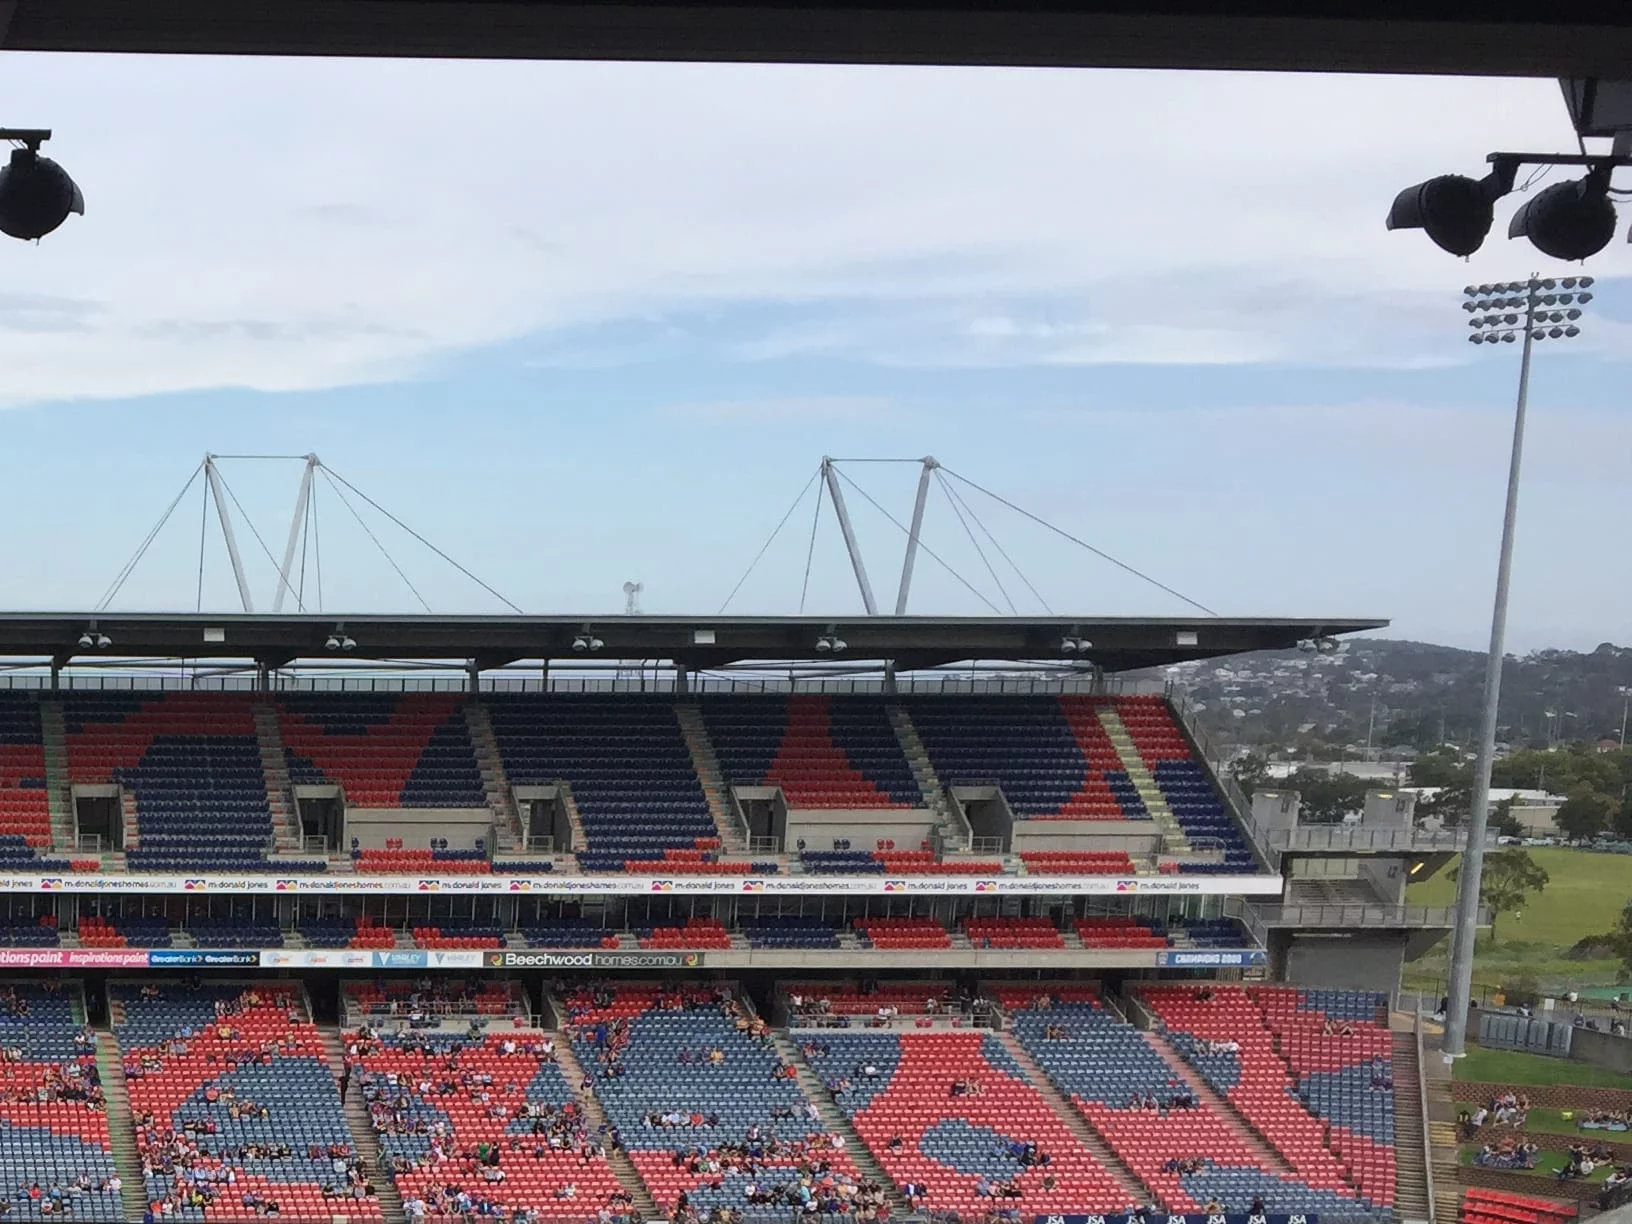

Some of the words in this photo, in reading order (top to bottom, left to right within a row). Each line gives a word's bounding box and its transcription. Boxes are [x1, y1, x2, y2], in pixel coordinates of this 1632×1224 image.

[11, 880, 33, 889] jones
[247, 880, 268, 890] jones
[505, 953, 593, 966] Beechwood
[1086, 1215, 1106, 1224] JSA
[1126, 1215, 1145, 1224] JSA
[1167, 1215, 1186, 1224] JSA
[1207, 1215, 1226, 1224] JSA
[1247, 1215, 1266, 1224] JSA
[1288, 1215, 1307, 1224] JSA
